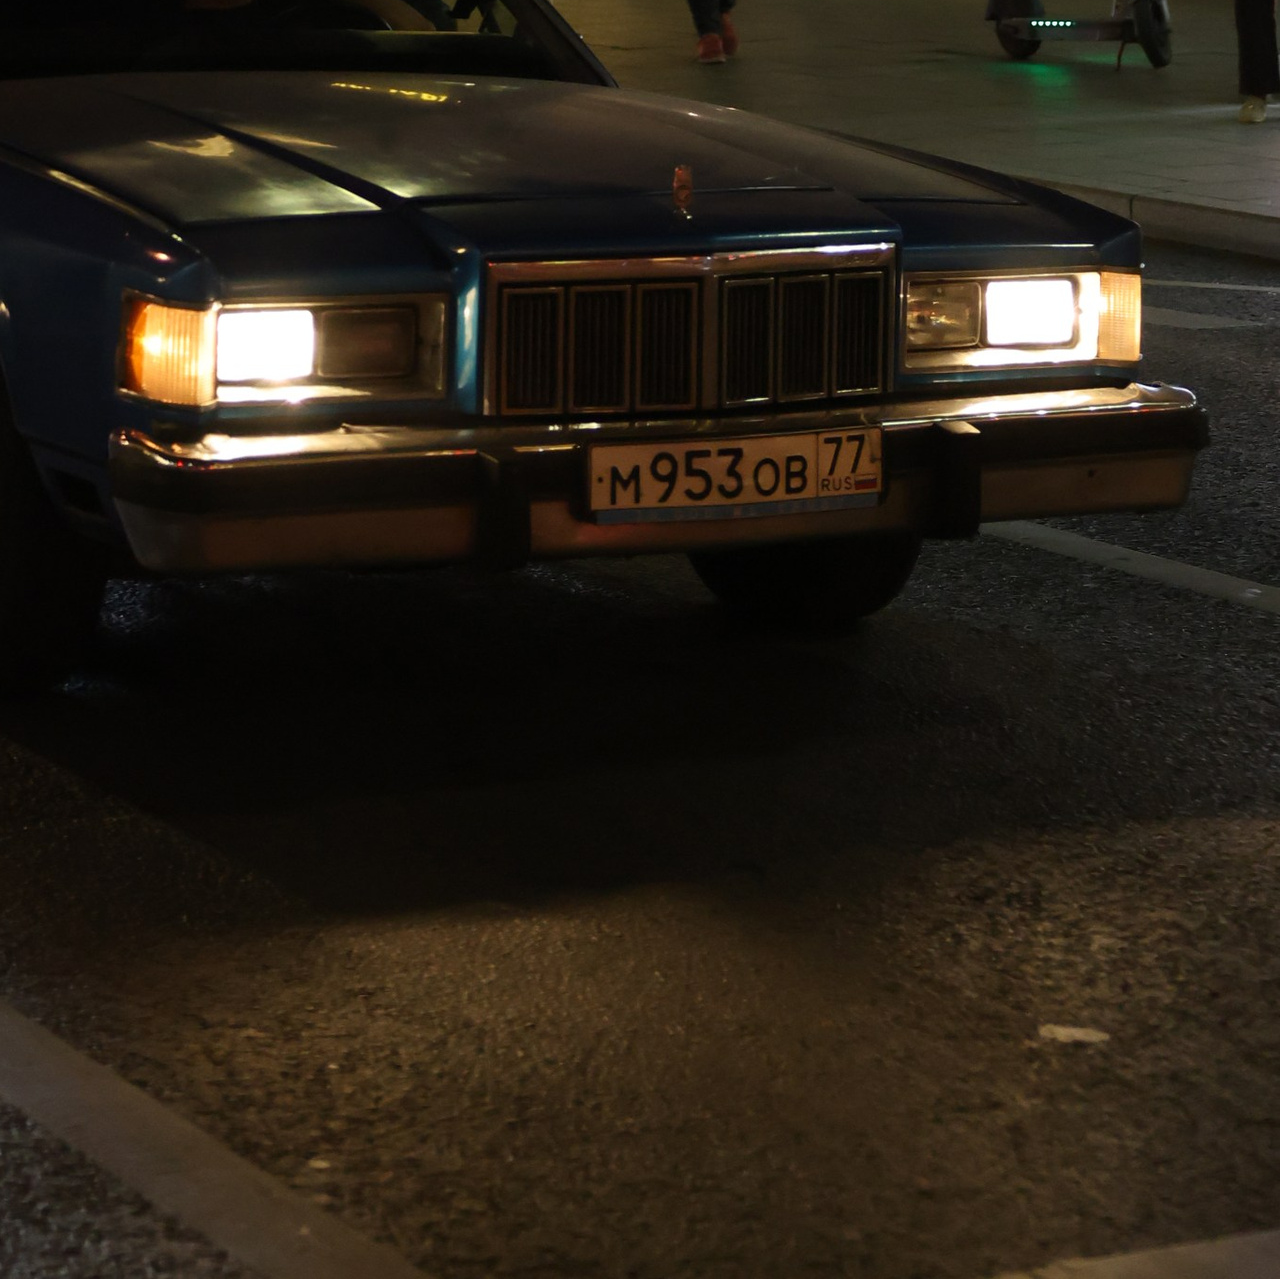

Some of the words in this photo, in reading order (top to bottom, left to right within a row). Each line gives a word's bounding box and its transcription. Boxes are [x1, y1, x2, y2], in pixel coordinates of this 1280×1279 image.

[609, 447, 809, 506] М953ОВ
[822, 434, 866, 476] 77
[821, 476, 852, 492] RUS
